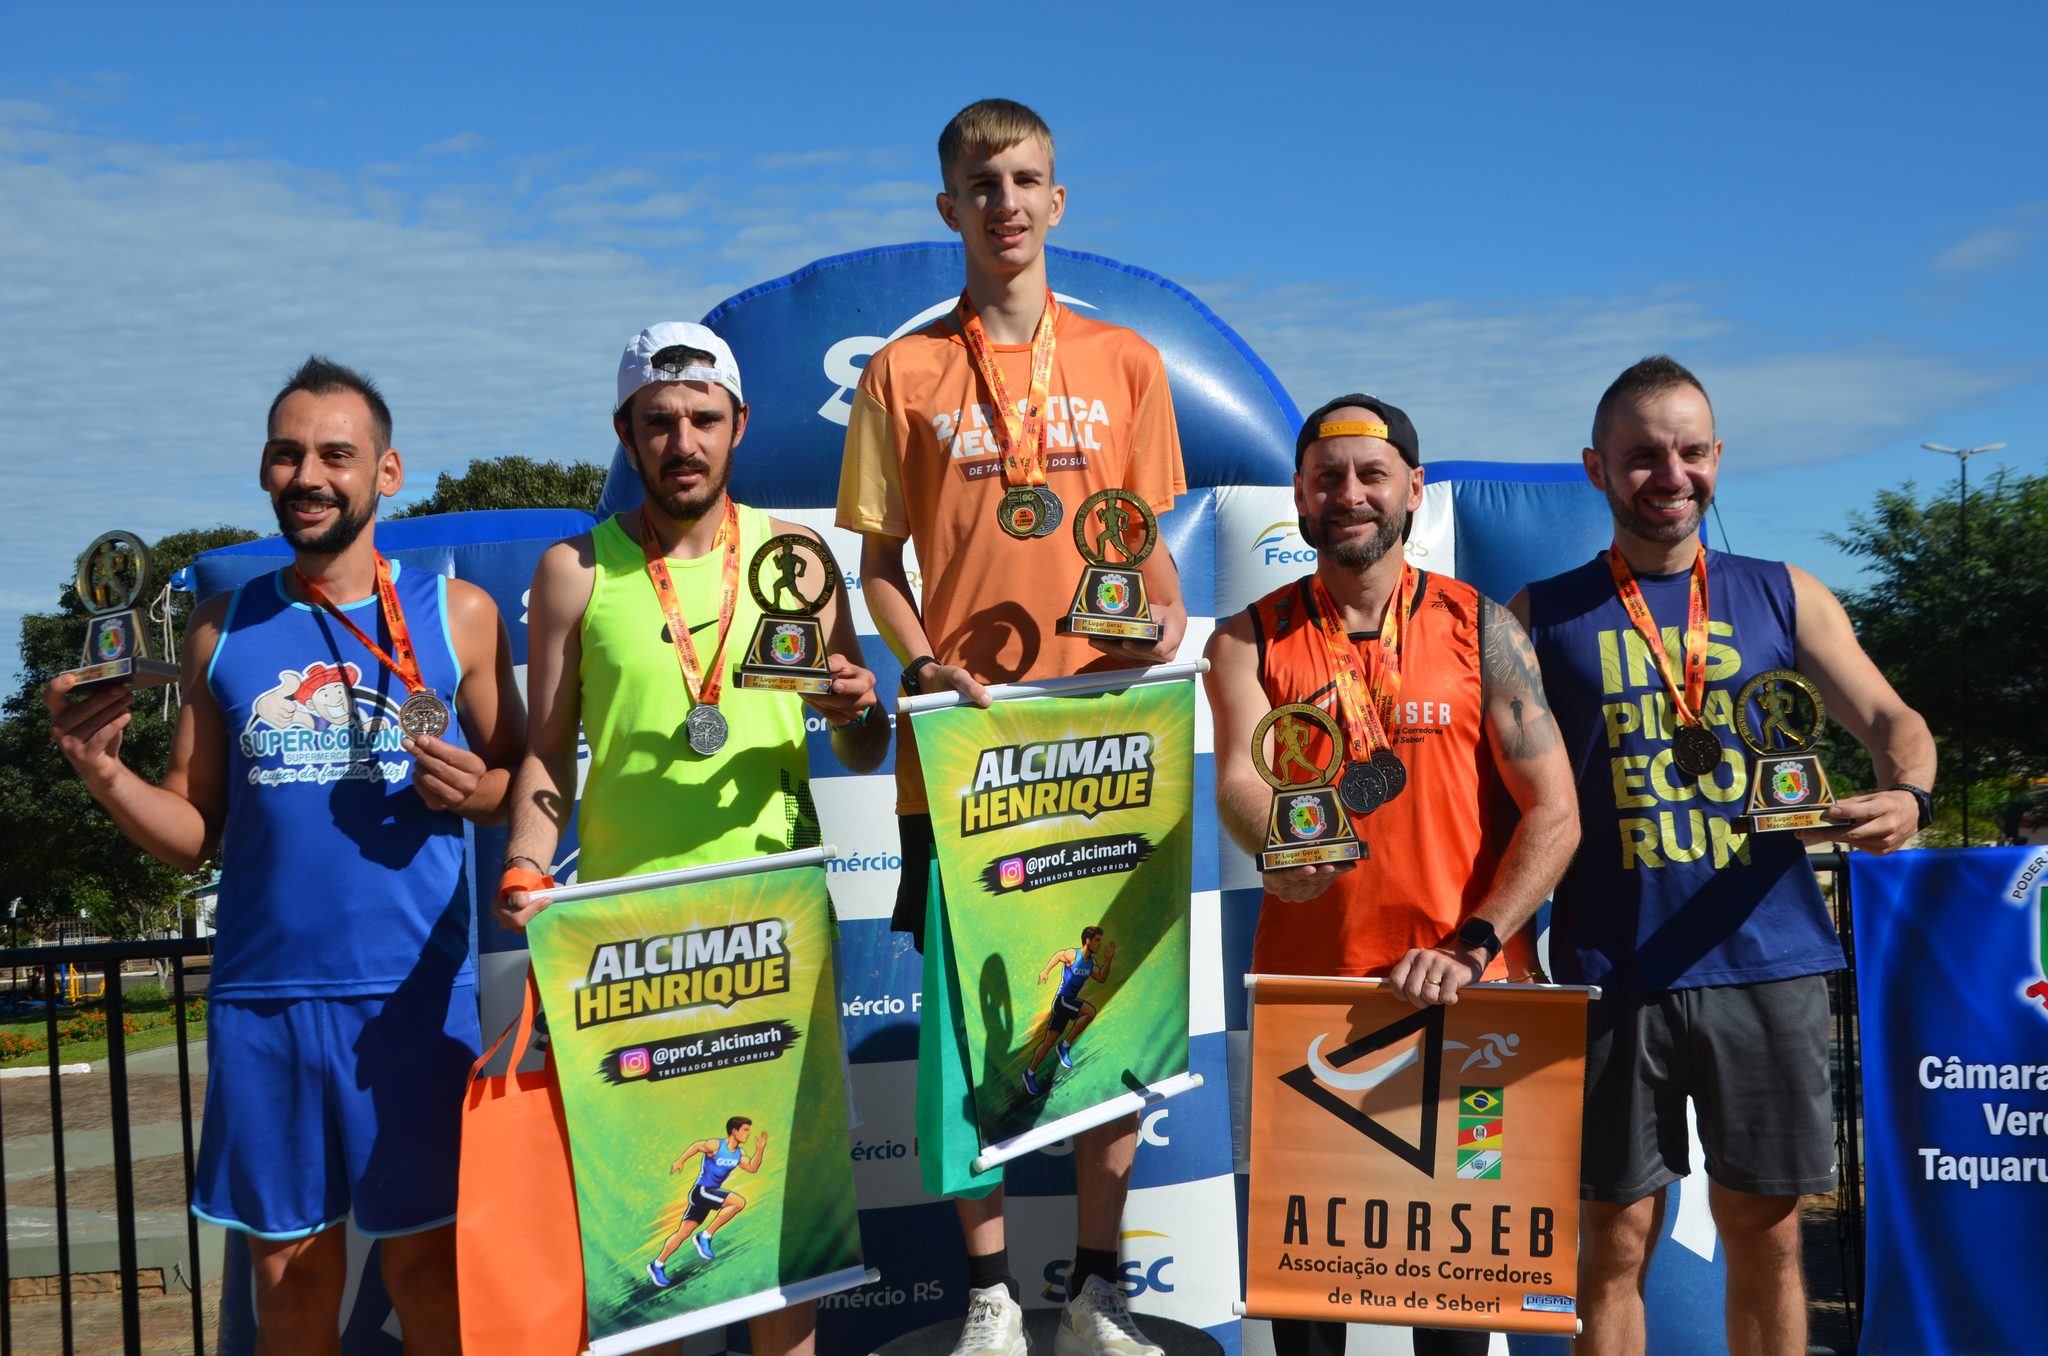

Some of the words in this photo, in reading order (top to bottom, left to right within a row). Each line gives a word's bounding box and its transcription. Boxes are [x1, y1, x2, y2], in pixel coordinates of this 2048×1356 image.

[971, 395, 1110, 429] RSTICA
[950, 420, 1102, 459] REGNAL
[969, 465, 983, 477] DE
[1052, 458, 1069, 468] DO
[1070, 457, 1087, 467] SUL
[760, 676, 778, 684] Lugar
[779, 677, 796, 685] Geral
[239, 729, 315, 757] SUPER
[320, 726, 408, 752] COLON
[1402, 727, 1443, 735] Corredores
[286, 751, 369, 763] SUPERMERCADOS
[974, 735, 1151, 792] ALCIMAR
[261, 769, 296, 785] super
[299, 765, 318, 779] da
[1610, 747, 1748, 810] ECO
[964, 771, 1149, 833] HENRIQUE
[1282, 851, 1301, 860] Lugar
[1301, 848, 1321, 856] Geral
[1618, 809, 1752, 870] RUN
[825, 851, 902, 874] mércio
[1025, 840, 1138, 875] @prof_alcimarh
[1030, 870, 1074, 887] TREINADOR
[1077, 867, 1088, 876] DE
[1091, 861, 1131, 874] CORRIDA
[2012, 856, 2048, 899] PODER
[589, 919, 784, 985] ALCIMAR
[579, 956, 785, 1025] HENRIQUE
[652, 1027, 782, 1066] @prof_alcimarh
[658, 1061, 714, 1078] TREINADOR
[717, 1058, 729, 1067] DE
[733, 1050, 776, 1064] CORRIDA
[1918, 1055, 2048, 1091] Câmara
[1283, 1194, 1555, 1258] ACORSEB
[1277, 1252, 1389, 1280] Associação
[1394, 1256, 1432, 1278] dos
[1437, 1261, 1553, 1285] Corredores
[913, 1280, 944, 1303] RS
[1327, 1286, 1353, 1305] de
[1359, 1289, 1397, 1308] Rua
[1403, 1291, 1429, 1310] de
[1435, 1293, 1501, 1314] Seberi
